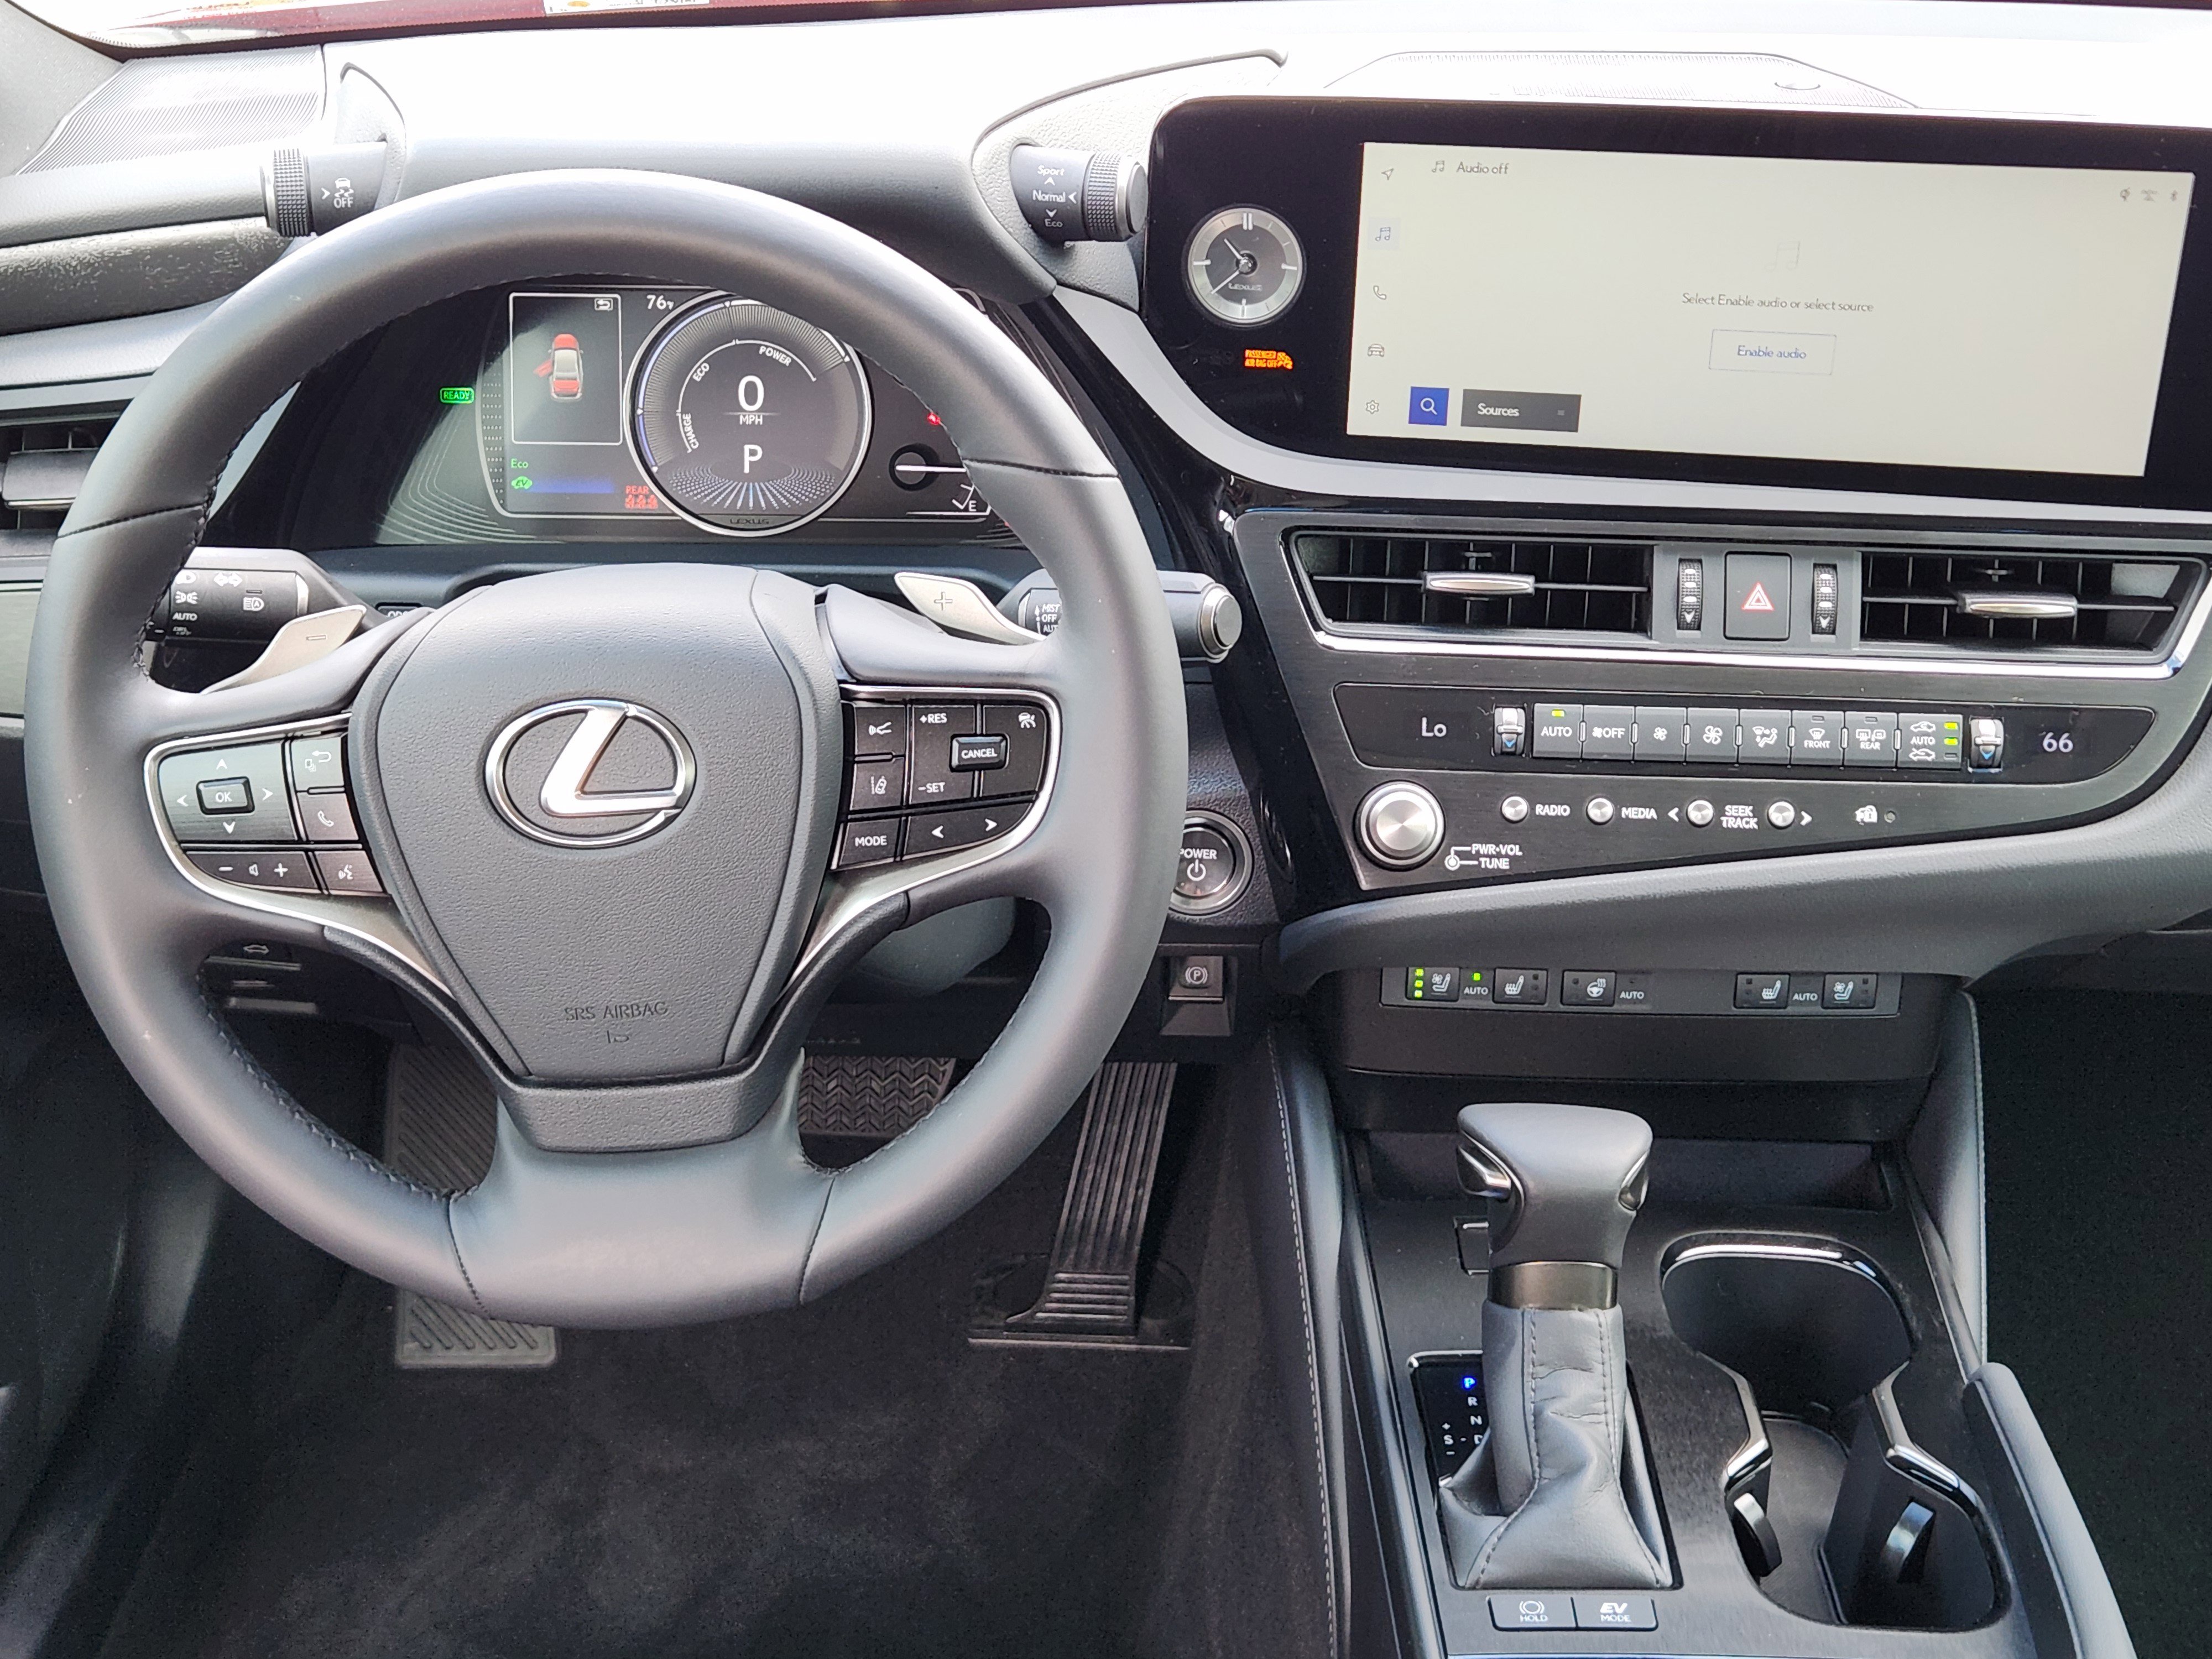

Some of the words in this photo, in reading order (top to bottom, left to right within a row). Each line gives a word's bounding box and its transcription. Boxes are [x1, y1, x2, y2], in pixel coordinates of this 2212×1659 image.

[1037, 165, 1065, 176] Sport
[1456, 161, 1489, 174] Audio
[1491, 163, 1510, 175] off
[1032, 189, 1066, 203] Normal
[333, 197, 354, 209] OFF
[1045, 218, 1063, 228] Eco
[1681, 292, 1715, 305] Select
[1718, 294, 1755, 307] Enable
[1757, 296, 1787, 309] audio
[1790, 300, 1800, 309] or
[1804, 298, 1835, 310] select
[1838, 302, 1874, 312] source
[759, 346, 792, 367] POWER
[1737, 345, 1774, 357] Enable
[1776, 347, 1807, 360] audio
[692, 362, 710, 382] ECO
[443, 390, 471, 400] READY
[738, 375, 765, 411] 0
[1477, 403, 1520, 417] Sources
[739, 414, 763, 425] MPH
[682, 413, 700, 450] CHARGE
[511, 458, 529, 469] Eco
[743, 445, 763, 473] P
[625, 485, 650, 495] REAR
[968, 500, 977, 512] E
[1041, 603, 1061, 613] MIST
[172, 612, 198, 622] AUTO
[1041, 613, 1058, 623] OFF
[1043, 624, 1058, 633] AUT
[1421, 717, 1447, 737] Lo
[1540, 726, 1572, 737] AUTO
[1603, 728, 1626, 739] OFF
[1803, 739, 1832, 749] FRONT
[1860, 742, 1881, 750] REAR
[1910, 736, 1936, 745] AUTO
[2042, 731, 2074, 753] 66
[961, 748, 998, 759] CANCEL
[215, 791, 232, 803] OK
[1535, 804, 1571, 817] RADIO
[1621, 807, 1658, 820] MEDIA
[1724, 805, 1754, 818] SEEK
[1720, 816, 1759, 830] TRACK
[854, 835, 888, 847] MODE
[1479, 857, 1510, 869] TUNE
[1463, 986, 1489, 995] AUTO
[1619, 990, 1645, 1000] AUTO
[1792, 993, 1818, 1001] AUTO
[564, 1006, 596, 1021] SRS
[602, 1000, 669, 1020] AIRBAG
[1464, 1377, 1475, 1389] P
[1468, 1396, 1478, 1406] R
[1470, 1415, 1483, 1425] N
[1443, 1434, 1454, 1445] S
[1600, 1602, 1628, 1614] EV
[1520, 1614, 1548, 1623] HOLD
[1600, 1614, 1631, 1623] MODE
